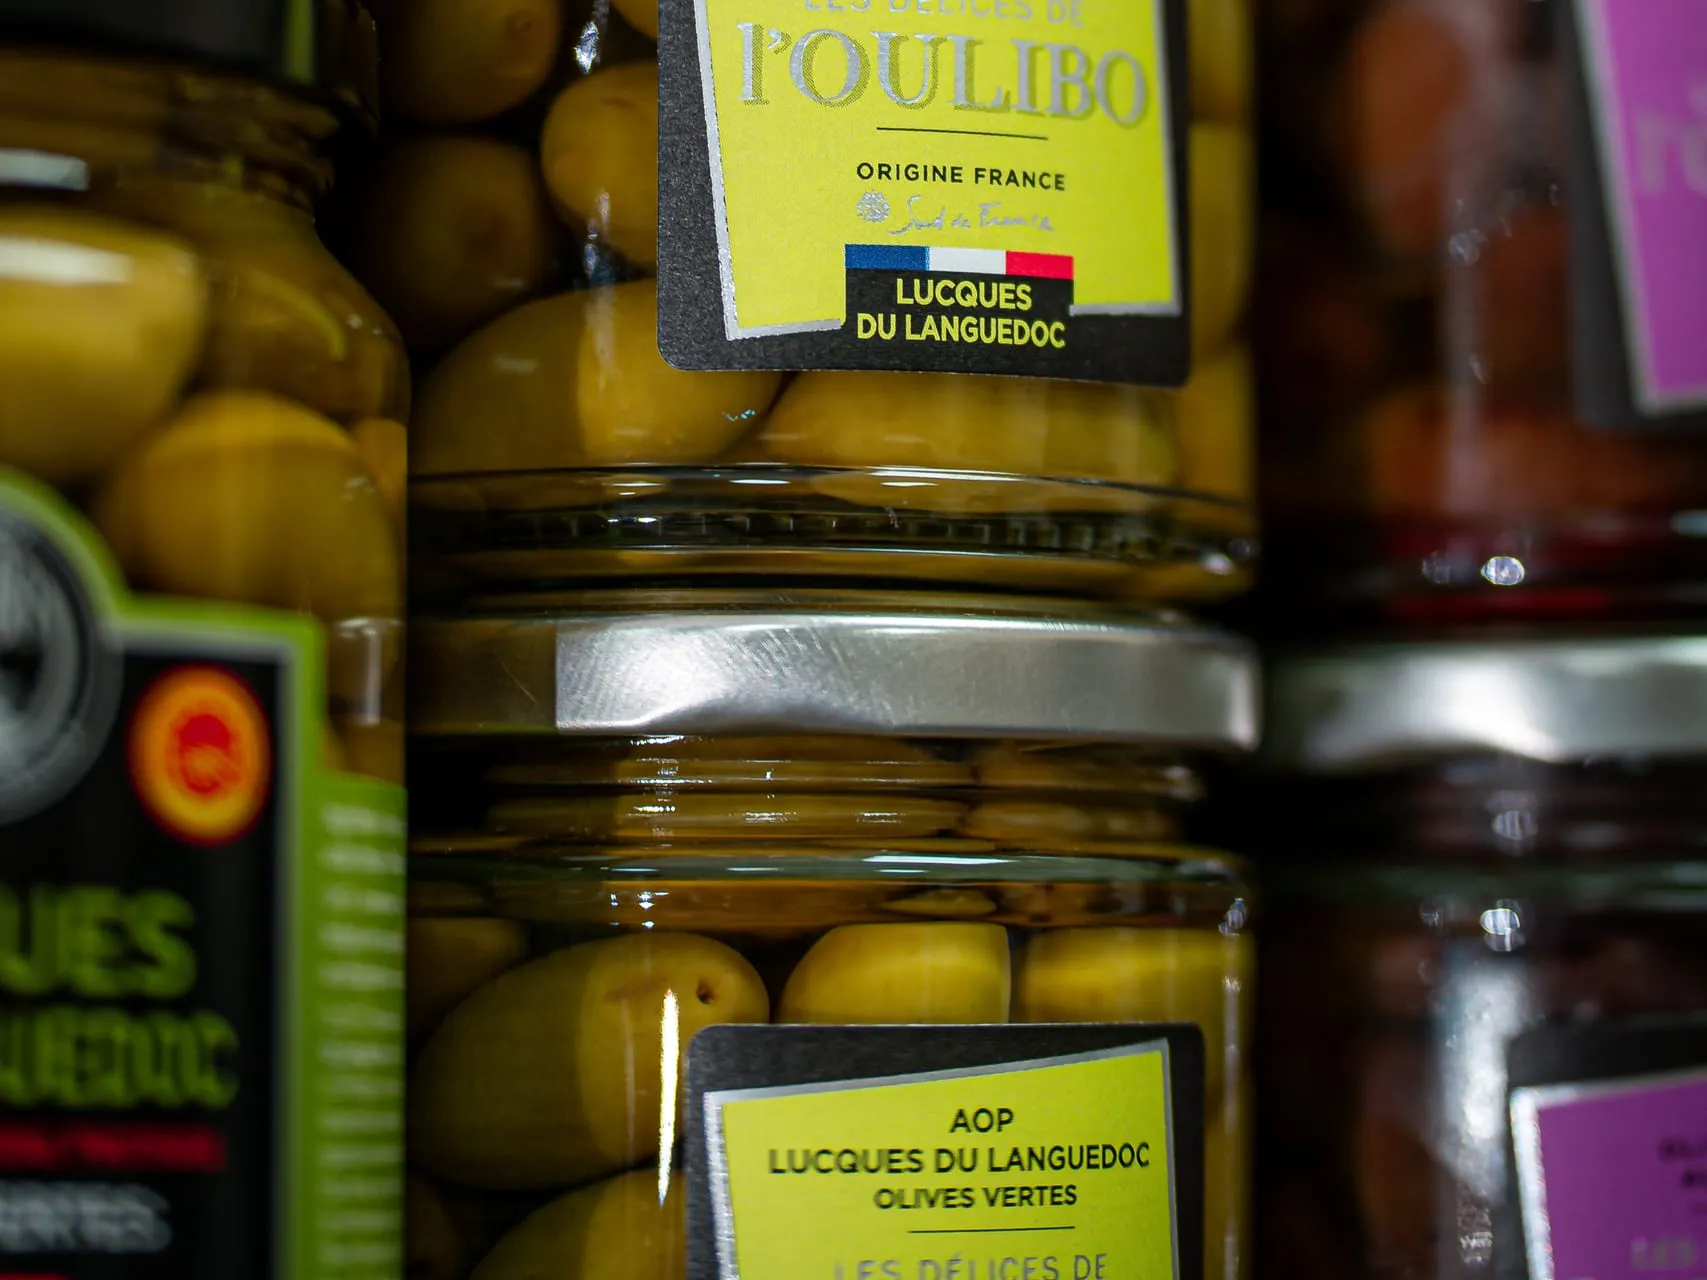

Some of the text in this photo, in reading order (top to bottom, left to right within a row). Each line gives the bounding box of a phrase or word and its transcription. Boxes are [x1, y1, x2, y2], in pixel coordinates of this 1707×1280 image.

[856, 161, 1066, 192] ORIGINE FRANCE
[895, 277, 1033, 312] LUCQUES
[856, 312, 1068, 350] DU LANGUEDOC
[949, 1107, 1016, 1135] AOP
[768, 1142, 1152, 1175] LUCQUES DU LANGUEDOC
[872, 1182, 1079, 1211] OLIVES VERTES
[832, 1251, 1109, 1280] LES DÉLICES DE
